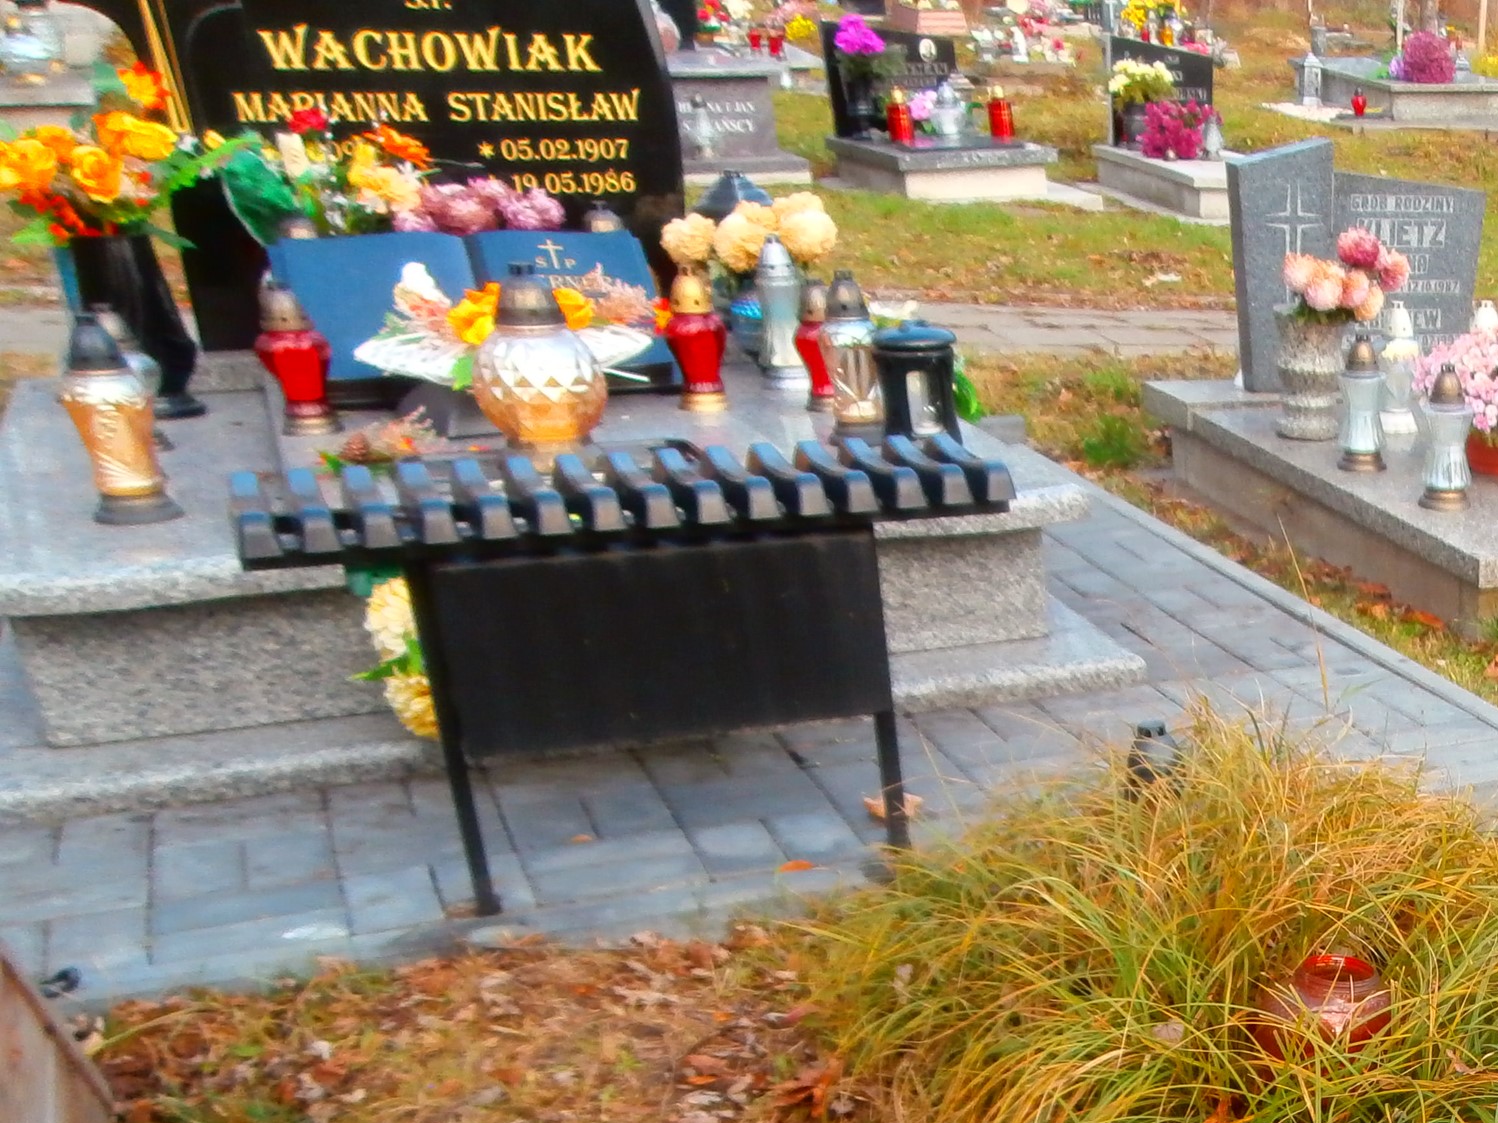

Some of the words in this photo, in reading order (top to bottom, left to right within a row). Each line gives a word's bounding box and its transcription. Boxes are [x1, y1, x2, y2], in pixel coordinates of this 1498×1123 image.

[256, 23, 603, 73] WACHOWIAK
[447, 88, 641, 122] STANISŁAW
[501, 138, 630, 162] 05.02.1907
